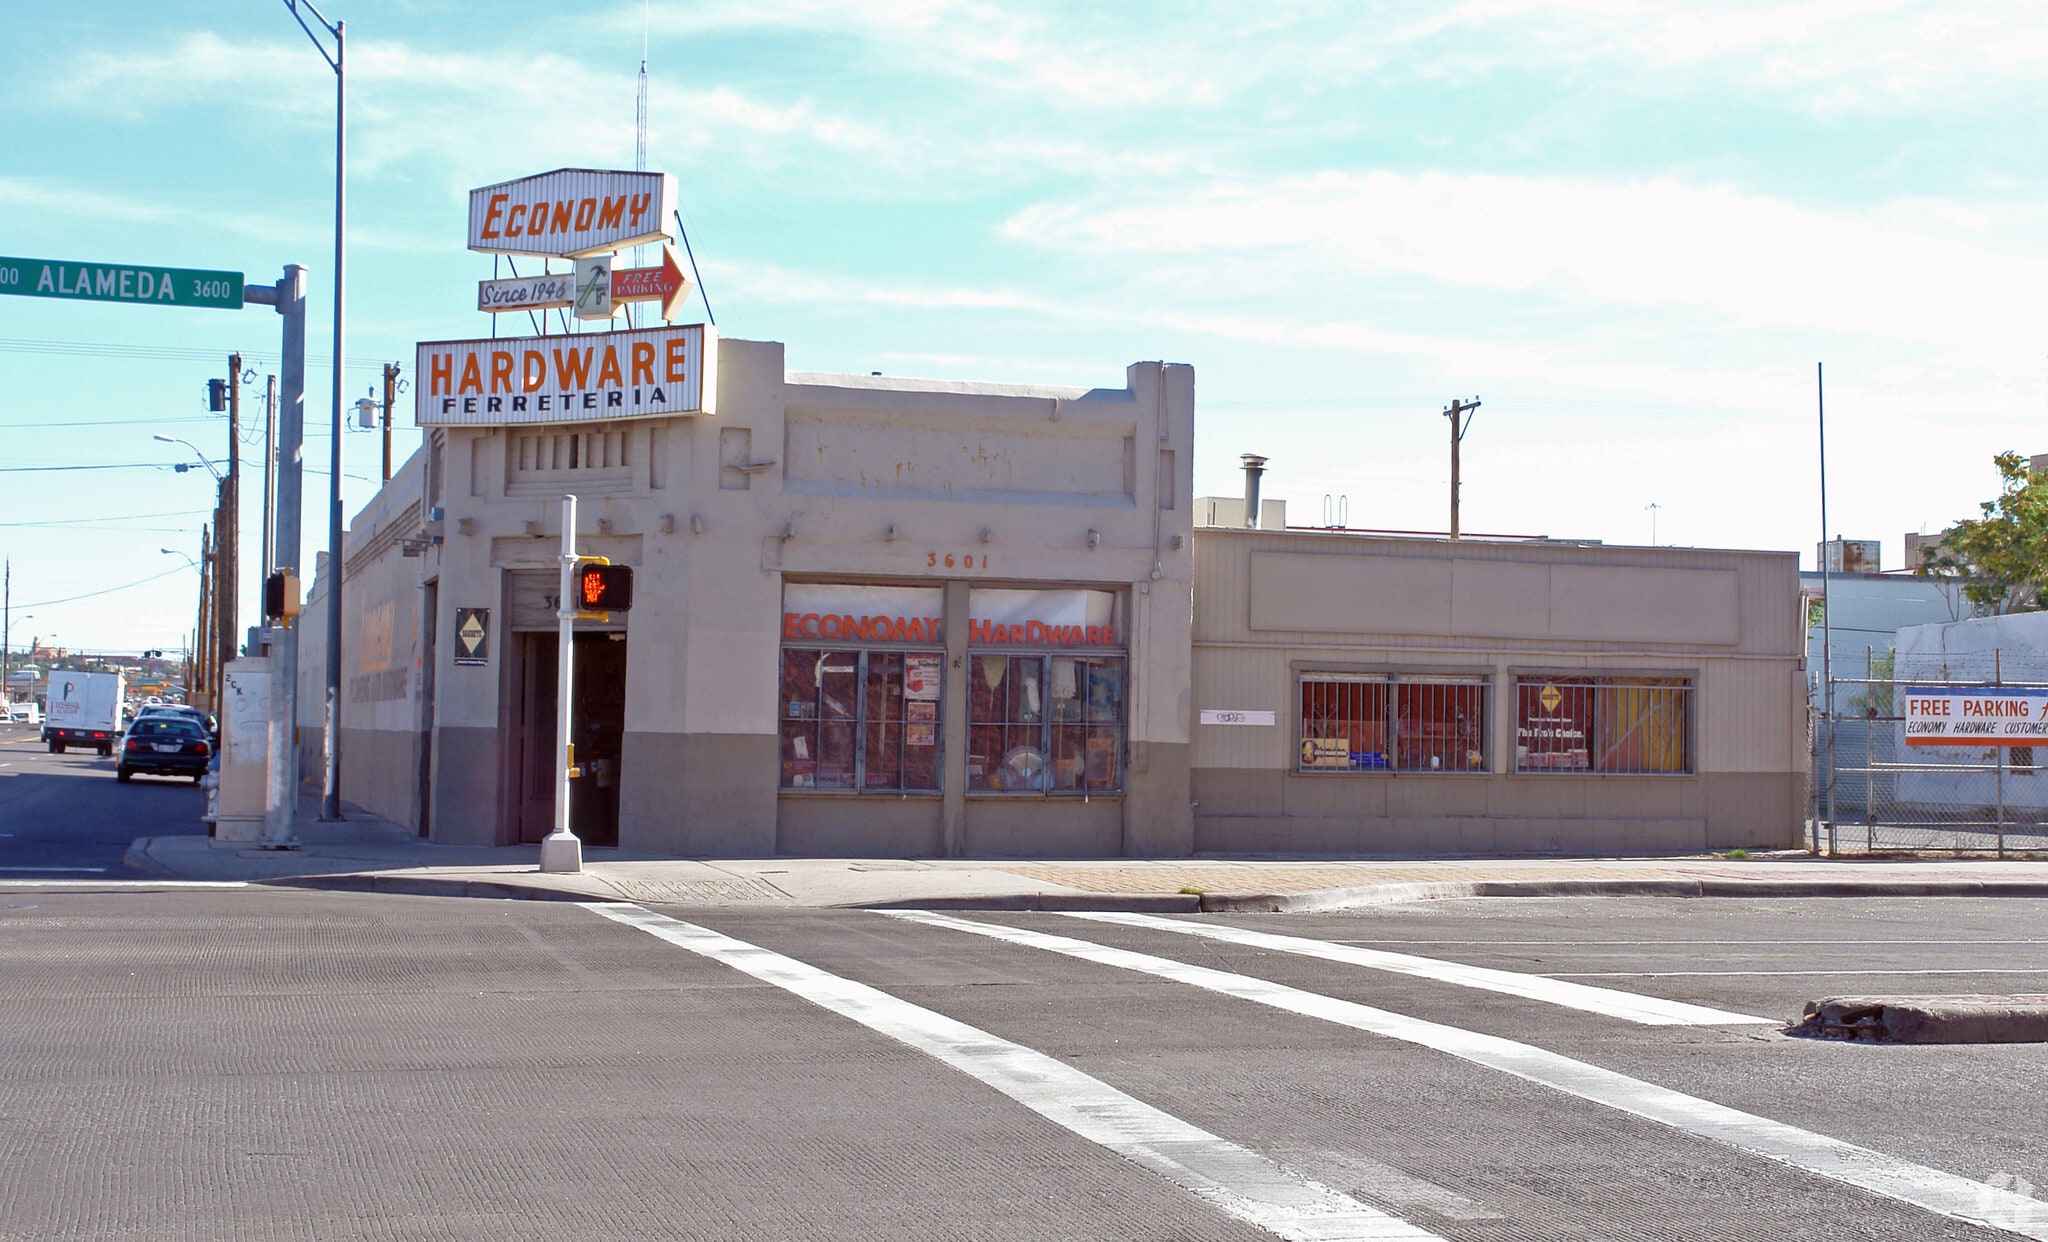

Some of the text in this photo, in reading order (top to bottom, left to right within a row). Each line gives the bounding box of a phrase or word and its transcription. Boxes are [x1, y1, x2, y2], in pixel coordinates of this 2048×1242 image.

[480, 193, 651, 239] ECONOMY
[0, 264, 231, 300] 00 ALAMEDA 3600
[617, 282, 673, 296] PARKING
[623, 271, 663, 284] FREE
[482, 281, 567, 306] Since 1946
[431, 338, 686, 396] HARDWARE
[442, 387, 667, 414] FERRETERIA
[927, 552, 989, 569] 3601
[784, 612, 941, 642] ECONOMY
[1910, 699, 1951, 716] FREE
[1963, 700, 2029, 717] PARKING
[1907, 721, 1947, 734] ECONOMY
[1953, 721, 1997, 734] HARDWARE
